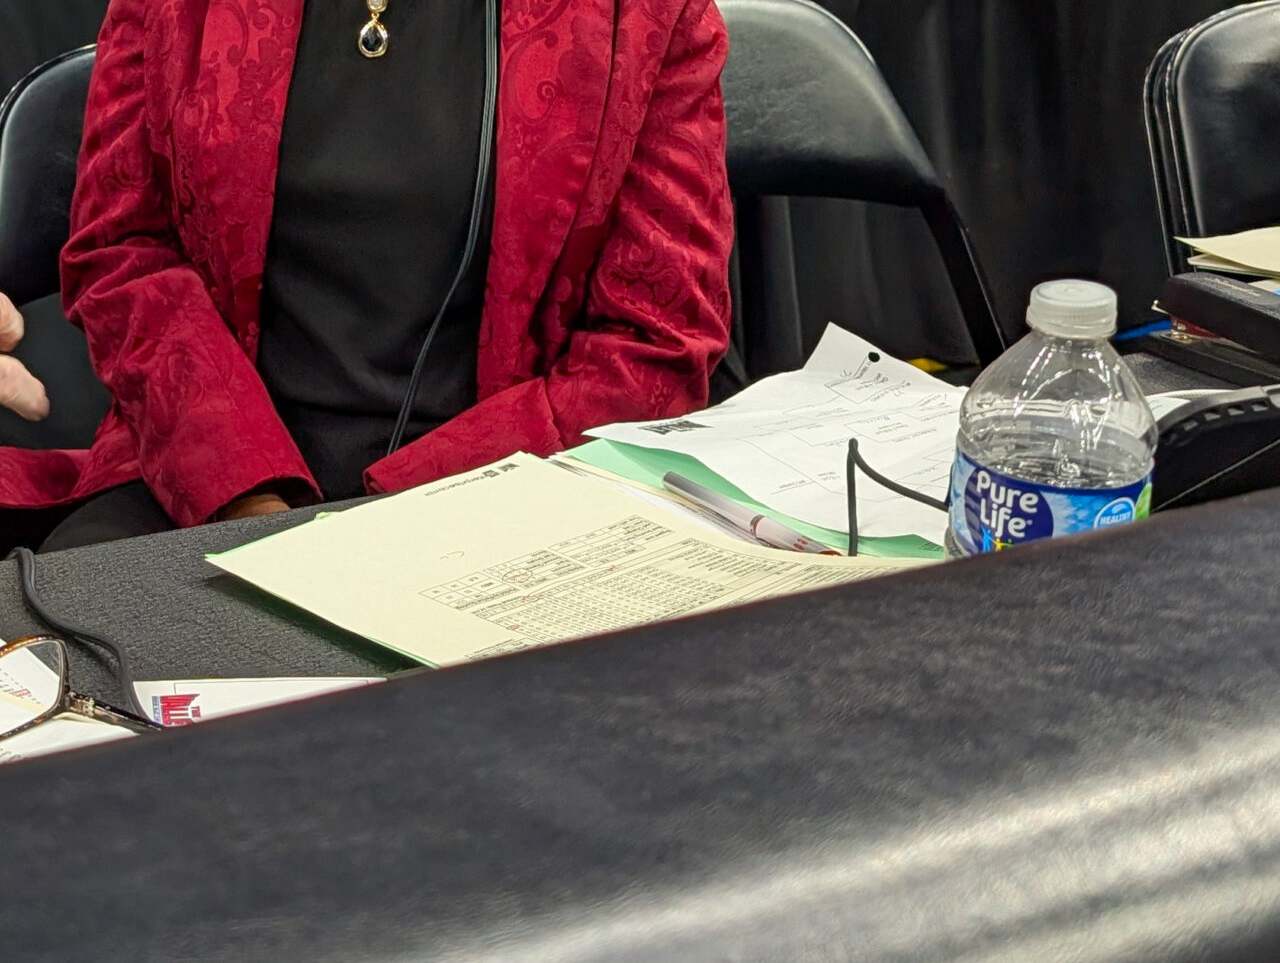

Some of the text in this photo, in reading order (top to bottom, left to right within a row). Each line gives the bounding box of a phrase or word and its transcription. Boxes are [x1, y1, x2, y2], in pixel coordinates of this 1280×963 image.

[977, 470, 1040, 514] Pure
[979, 498, 1027, 538] Life
[1099, 511, 1132, 526] HEALTHY
